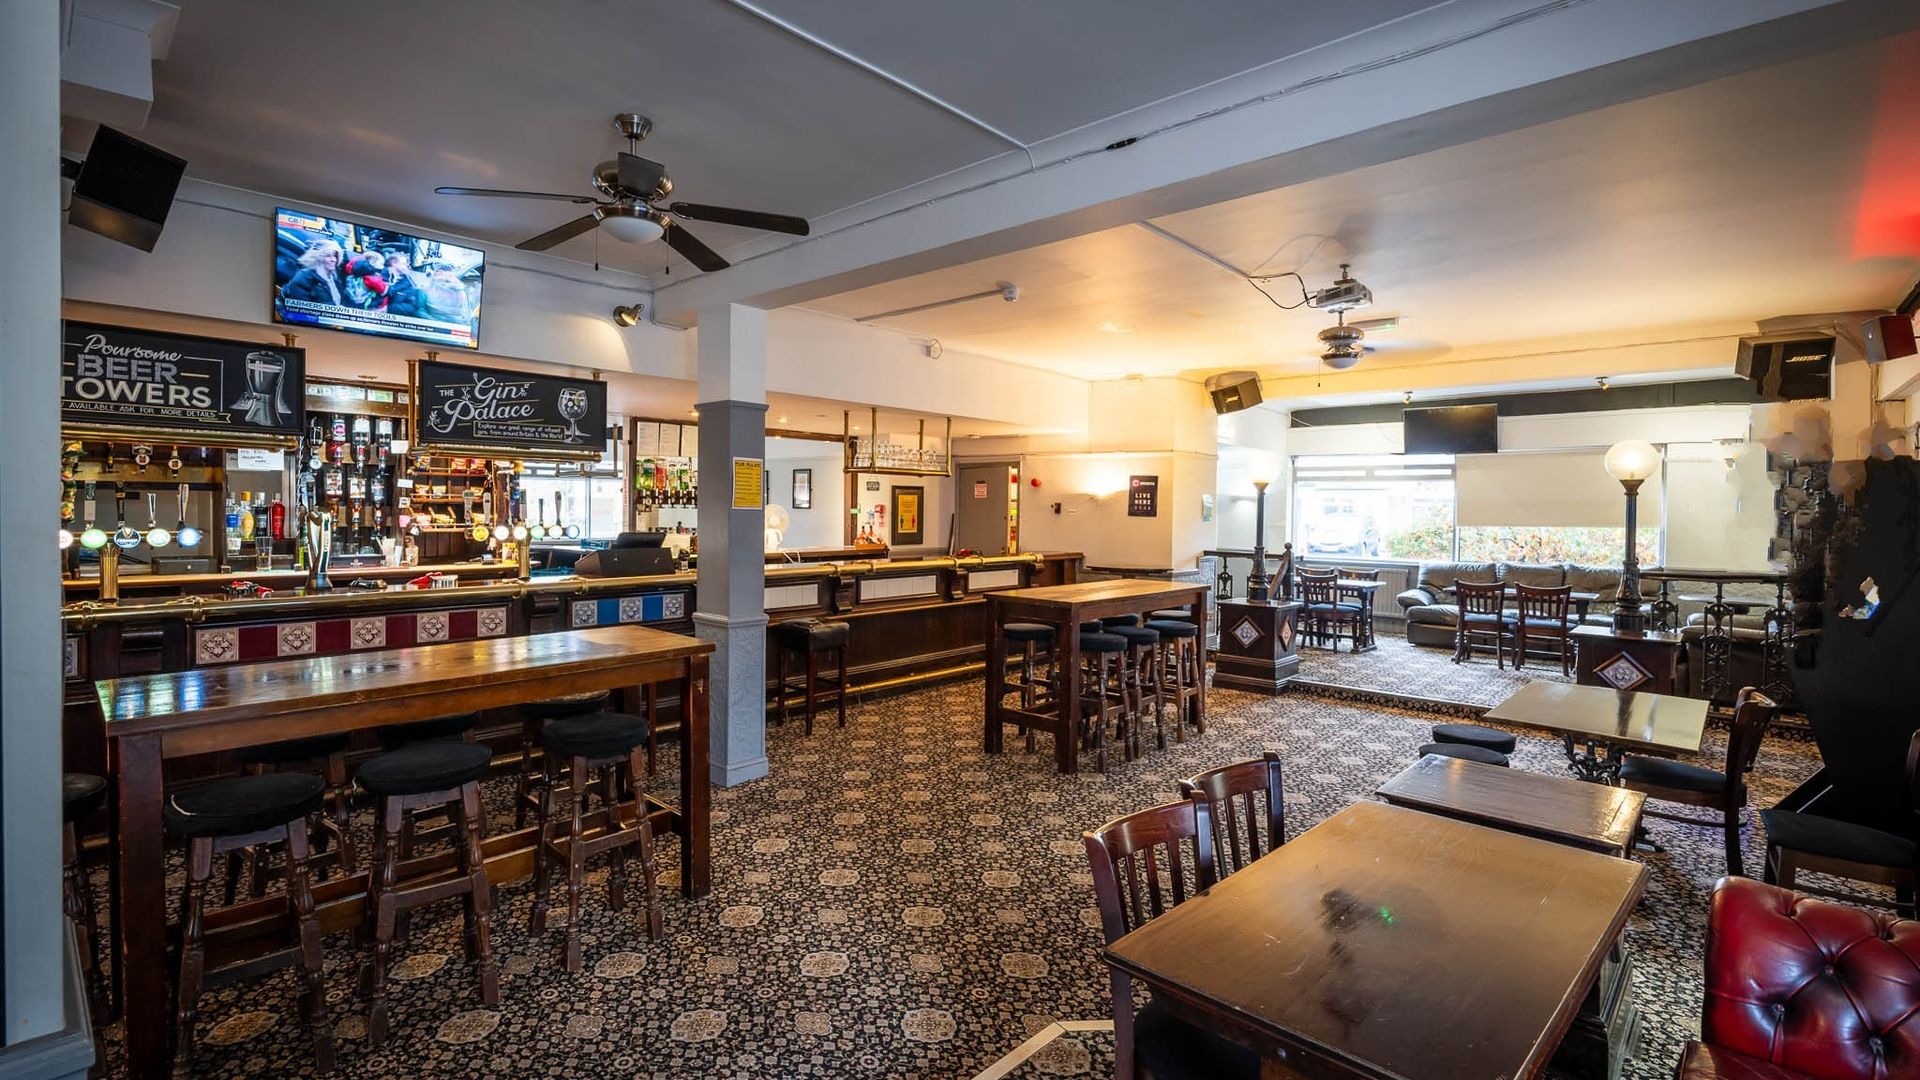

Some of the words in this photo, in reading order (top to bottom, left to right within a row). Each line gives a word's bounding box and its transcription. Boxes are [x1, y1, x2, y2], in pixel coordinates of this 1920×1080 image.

[285, 299, 323, 310] FARMERS
[324, 305, 350, 314] DOWN
[373, 311, 397, 320] TOOLS
[83, 334, 182, 361] Poursome
[77, 354, 177, 384] BEER
[439, 389, 455, 397] THE
[473, 372, 524, 408] Gin
[69, 402, 115, 412] AVAILABLE
[120, 405, 136, 413] ASK
[140, 407, 154, 415] FOR
[160, 408, 182, 416] MORE
[186, 409, 216, 418] DETAILS
[432, 398, 535, 434] Palace
